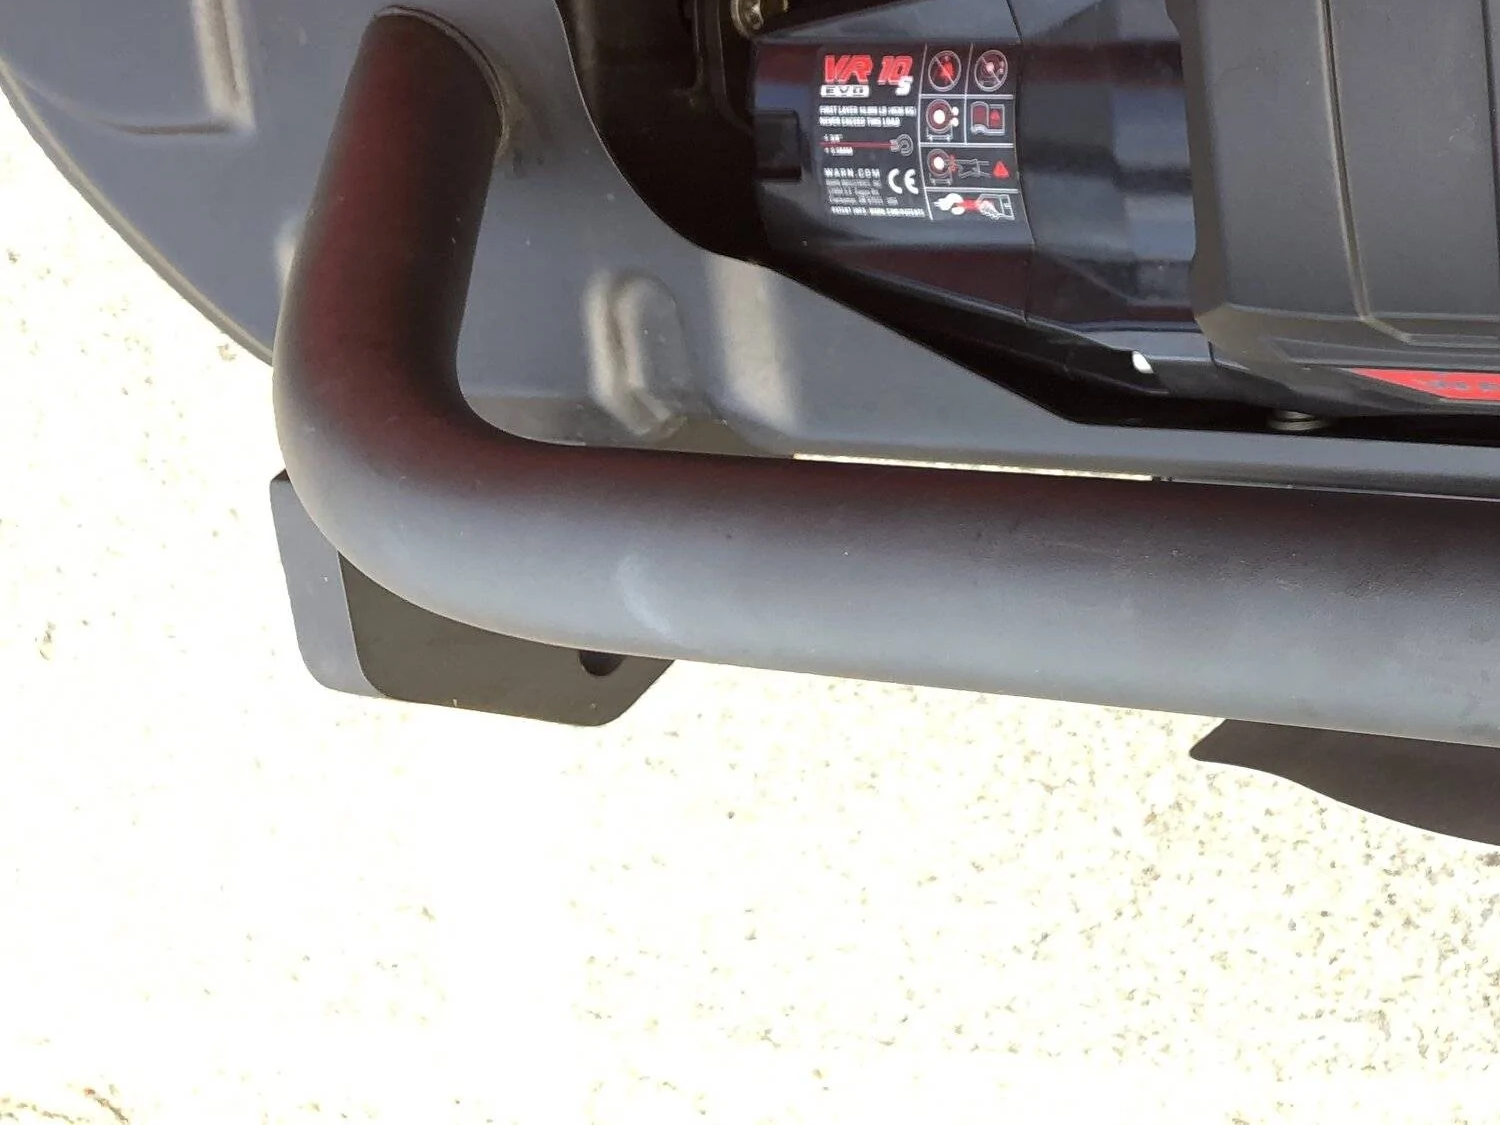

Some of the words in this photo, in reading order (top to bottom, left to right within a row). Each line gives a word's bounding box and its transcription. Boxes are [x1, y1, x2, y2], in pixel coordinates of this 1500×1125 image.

[824, 55, 873, 84] VR
[878, 56, 913, 85] 10
[824, 167, 880, 179] WARN.COM
